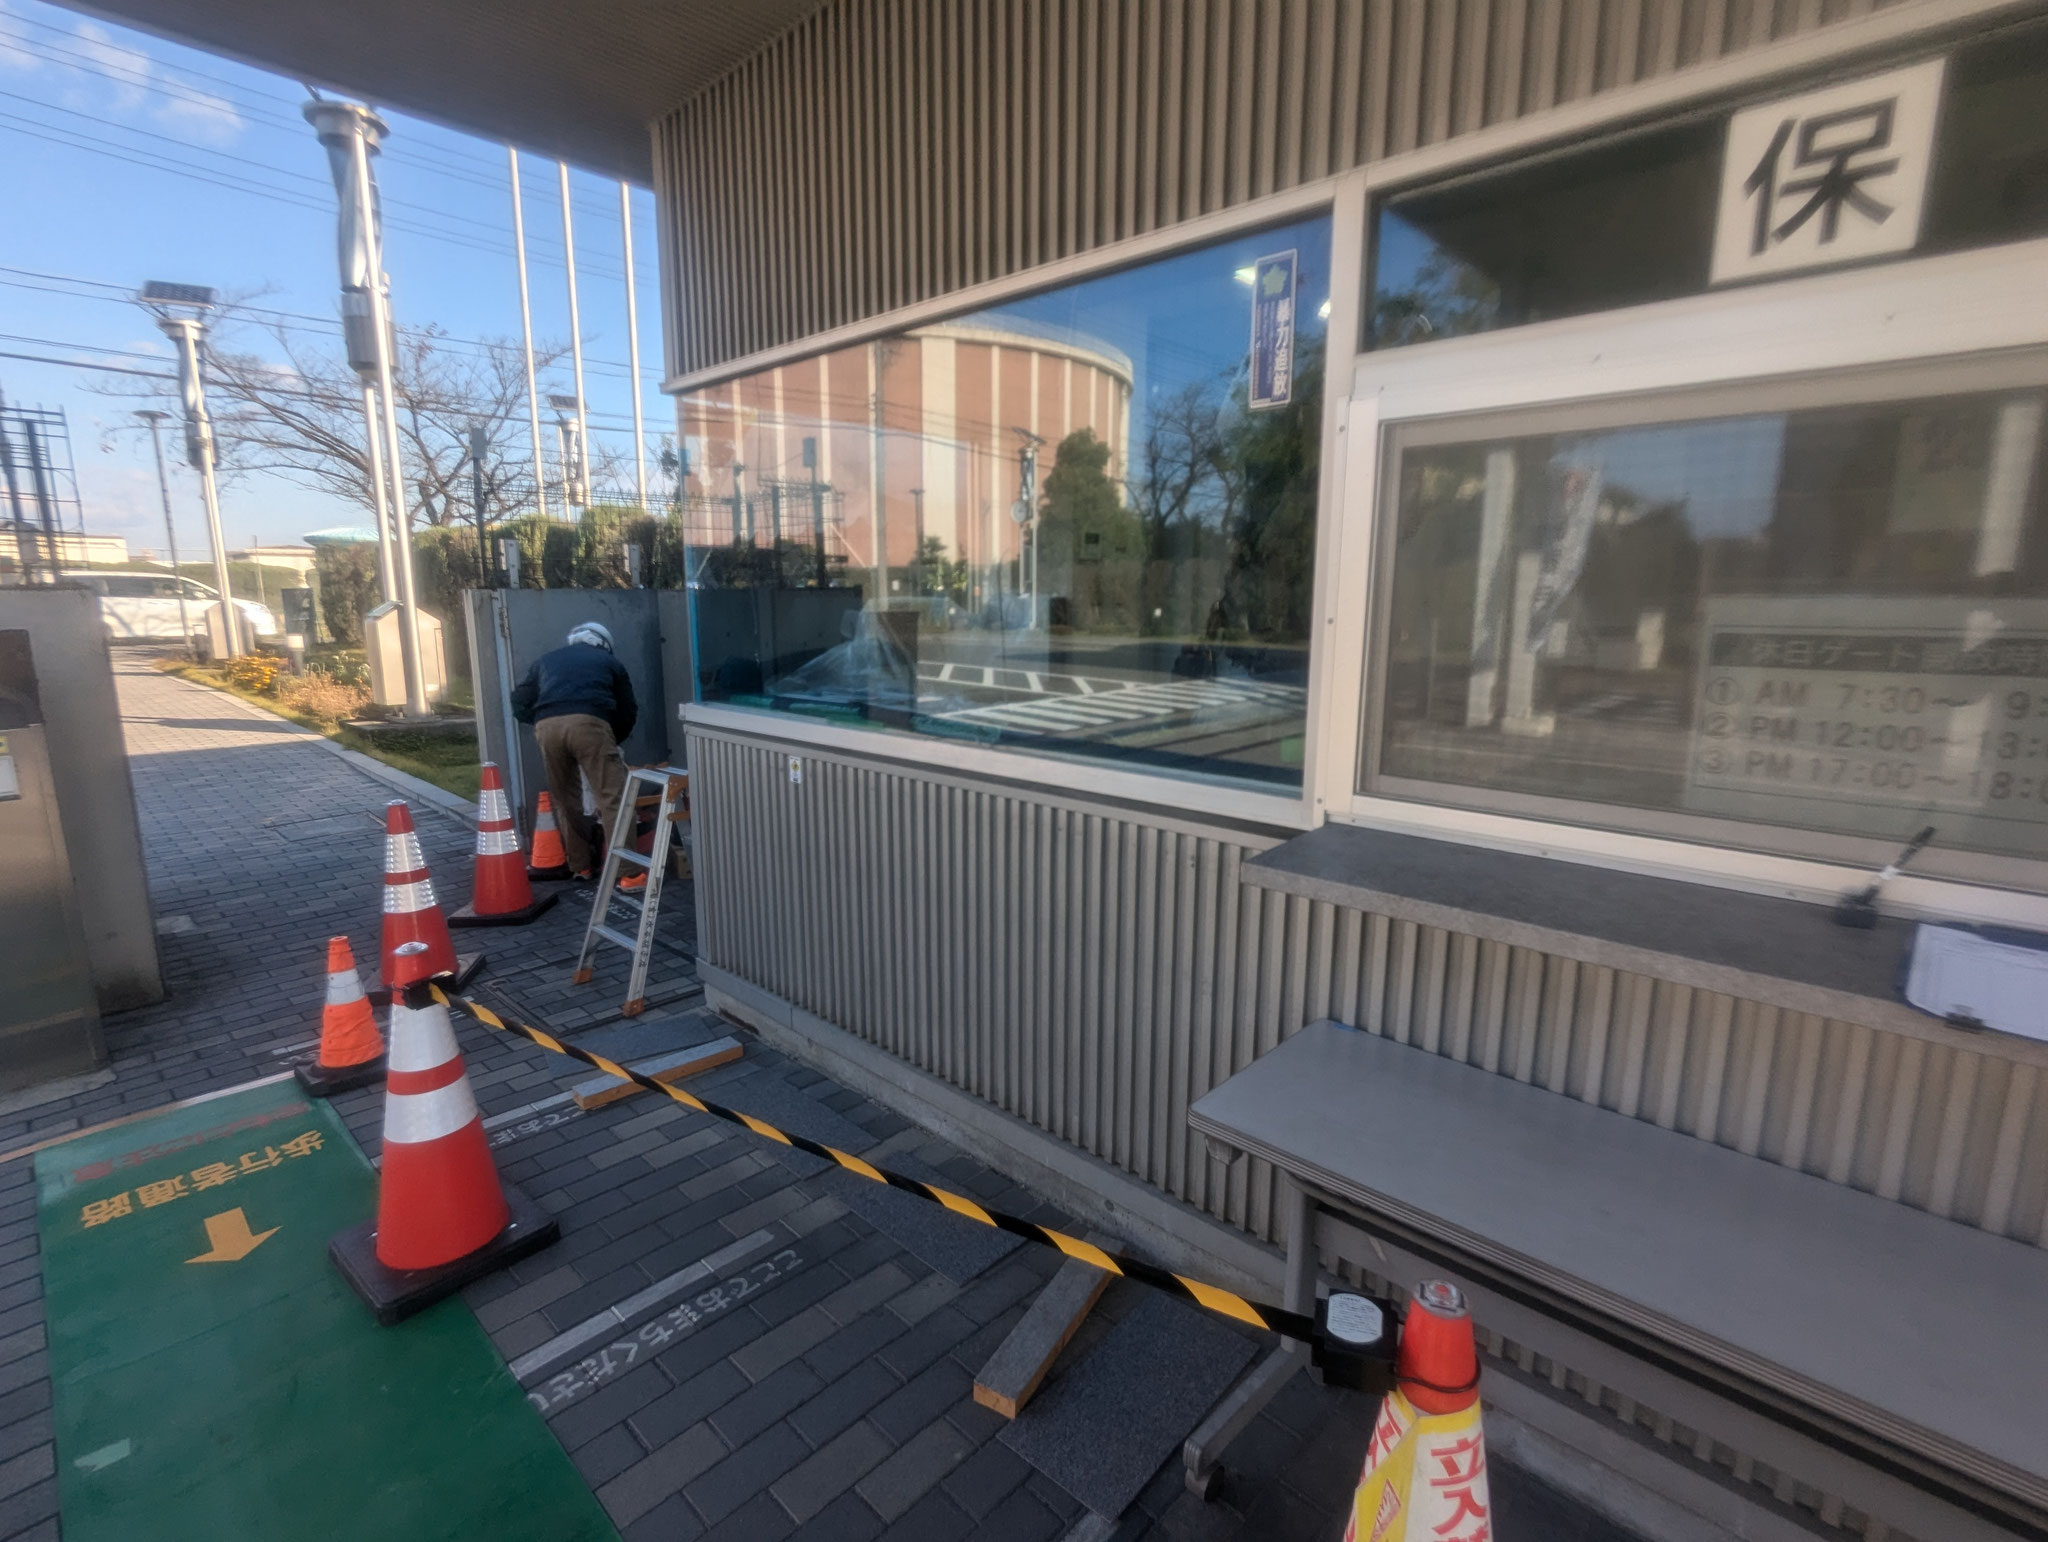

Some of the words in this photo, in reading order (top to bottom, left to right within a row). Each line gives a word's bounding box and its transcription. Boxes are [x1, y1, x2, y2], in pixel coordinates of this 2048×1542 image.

[1742, 95, 1902, 258] 保
[81, 1129, 325, 1229] 歩行者通路
[1430, 1431, 1489, 1542] 立入
